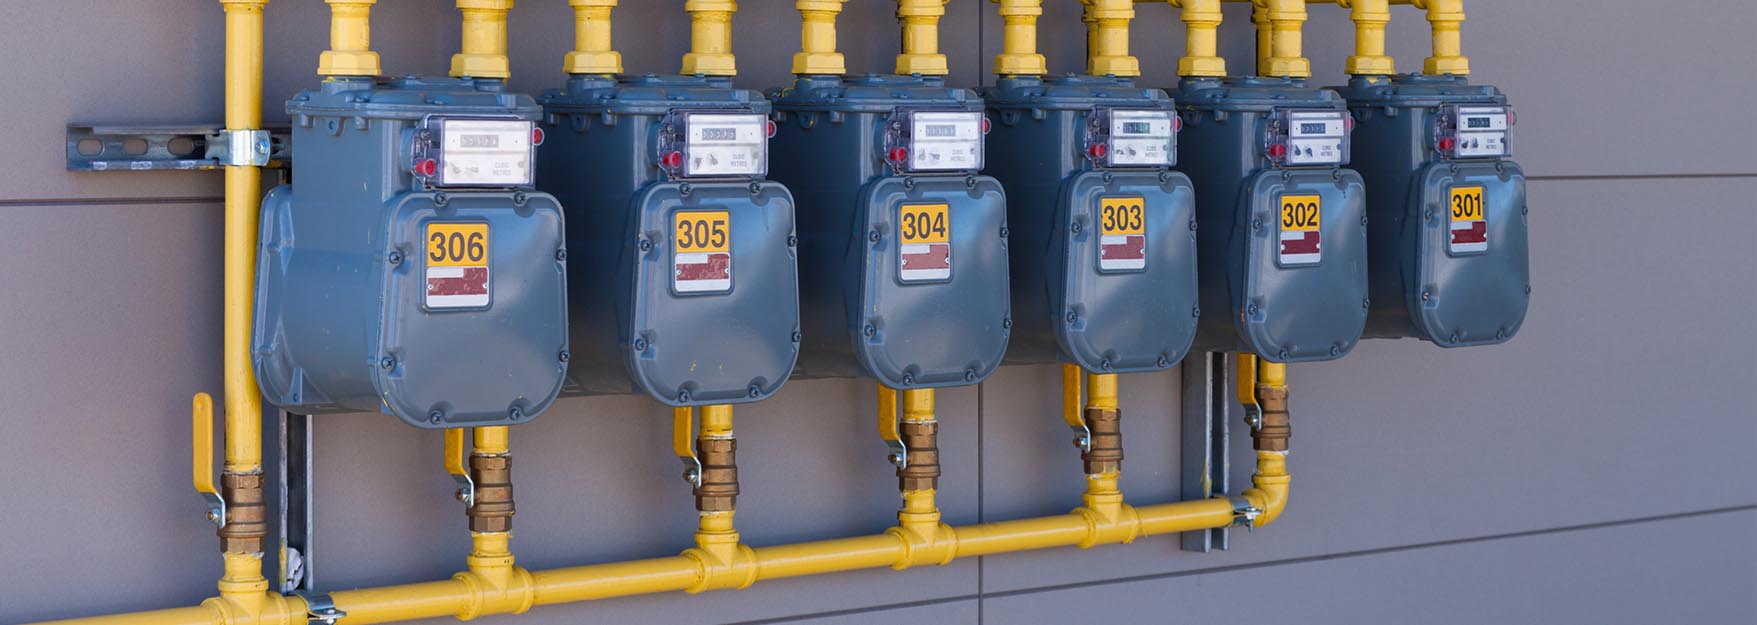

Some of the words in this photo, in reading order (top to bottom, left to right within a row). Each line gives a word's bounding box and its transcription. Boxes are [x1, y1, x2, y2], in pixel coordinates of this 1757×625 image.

[1103, 205, 1142, 231] 303
[1283, 202, 1318, 228] 302
[1452, 193, 1481, 218] 301
[678, 220, 726, 248] 305
[903, 212, 946, 240] 304
[430, 231, 484, 262] 306
